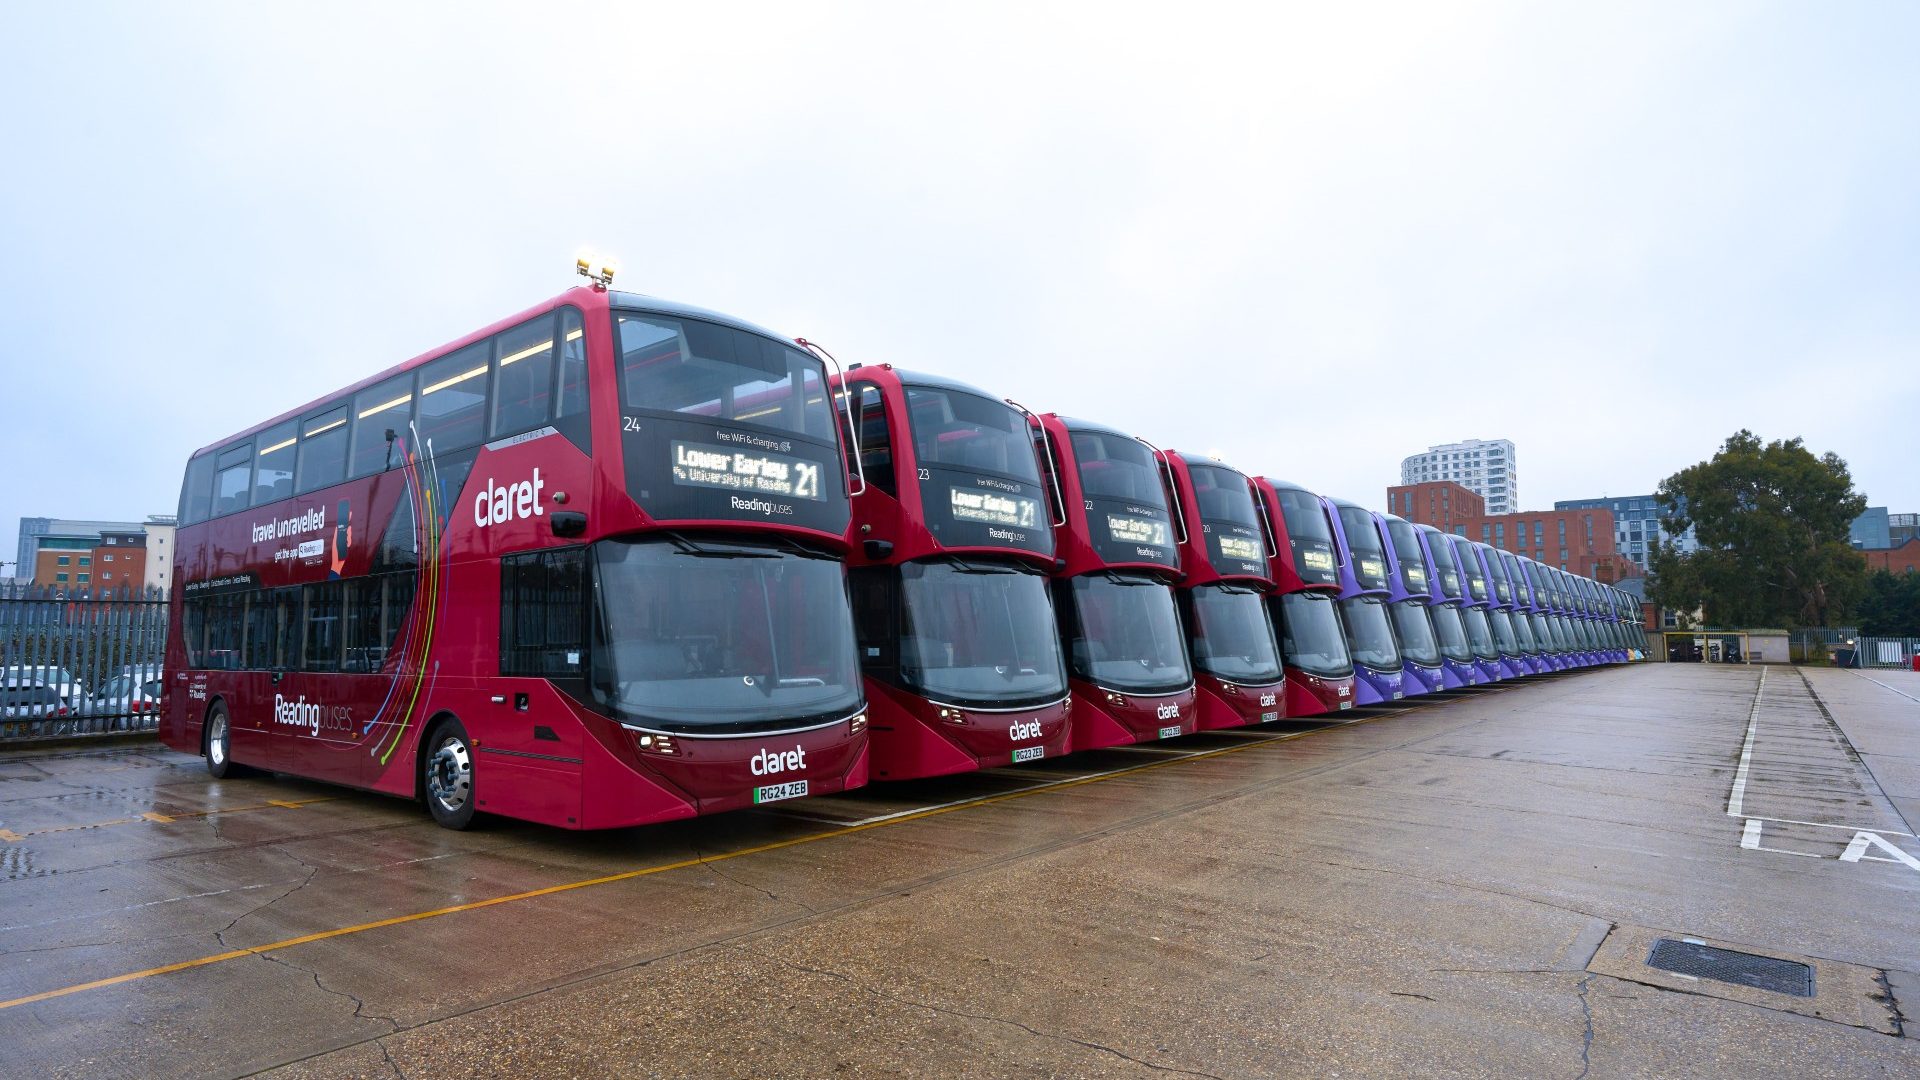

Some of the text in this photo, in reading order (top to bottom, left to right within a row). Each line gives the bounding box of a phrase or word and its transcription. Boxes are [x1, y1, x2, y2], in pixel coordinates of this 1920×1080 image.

[623, 416, 641, 432] 24
[716, 430, 731, 441] free
[731, 432, 746, 443] WiFi
[752, 436, 779, 451] charging
[677, 445, 789, 480] Lower Earley
[688, 468, 741, 487] University
[794, 462, 818, 497] 21
[917, 468, 930, 480] 23
[474, 467, 544, 528] claret
[1084, 500, 1094, 511] 22
[1019, 500, 1035, 527] 21
[252, 504, 326, 544] travel unravelled
[274, 548, 299, 563] get the app
[1260, 692, 1277, 707] claret
[1157, 701, 1180, 720] claret
[1009, 717, 1043, 741] claret
[750, 744, 807, 776] claret
[1016, 747, 1043, 761] RG23 ZEB
[760, 782, 806, 801] RG24 ZEB
